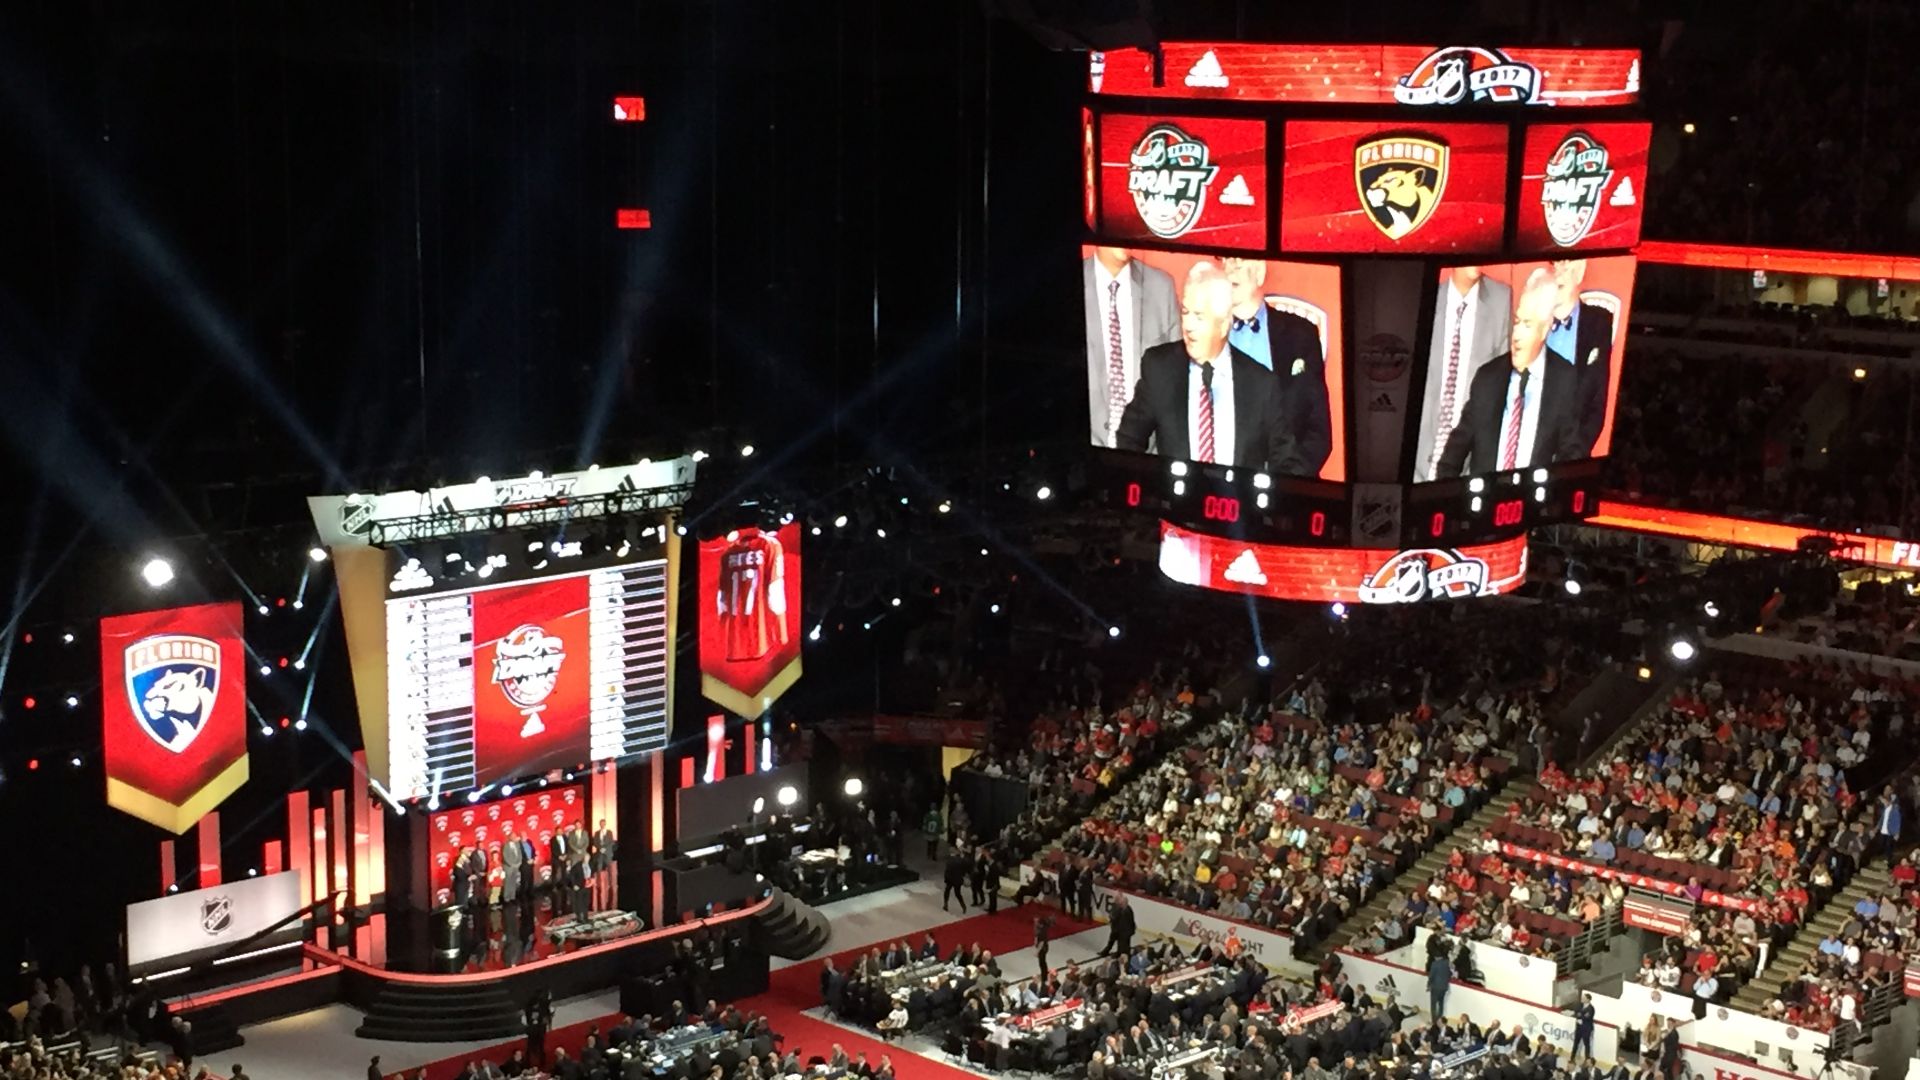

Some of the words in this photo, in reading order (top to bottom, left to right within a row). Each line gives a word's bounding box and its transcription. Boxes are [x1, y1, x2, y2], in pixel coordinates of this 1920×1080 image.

[1478, 69, 1520, 84] 2017
[1361, 143, 1435, 164] FLORIDA
[1129, 168, 1208, 198] DRAFT
[1436, 565, 1472, 581] 2017
